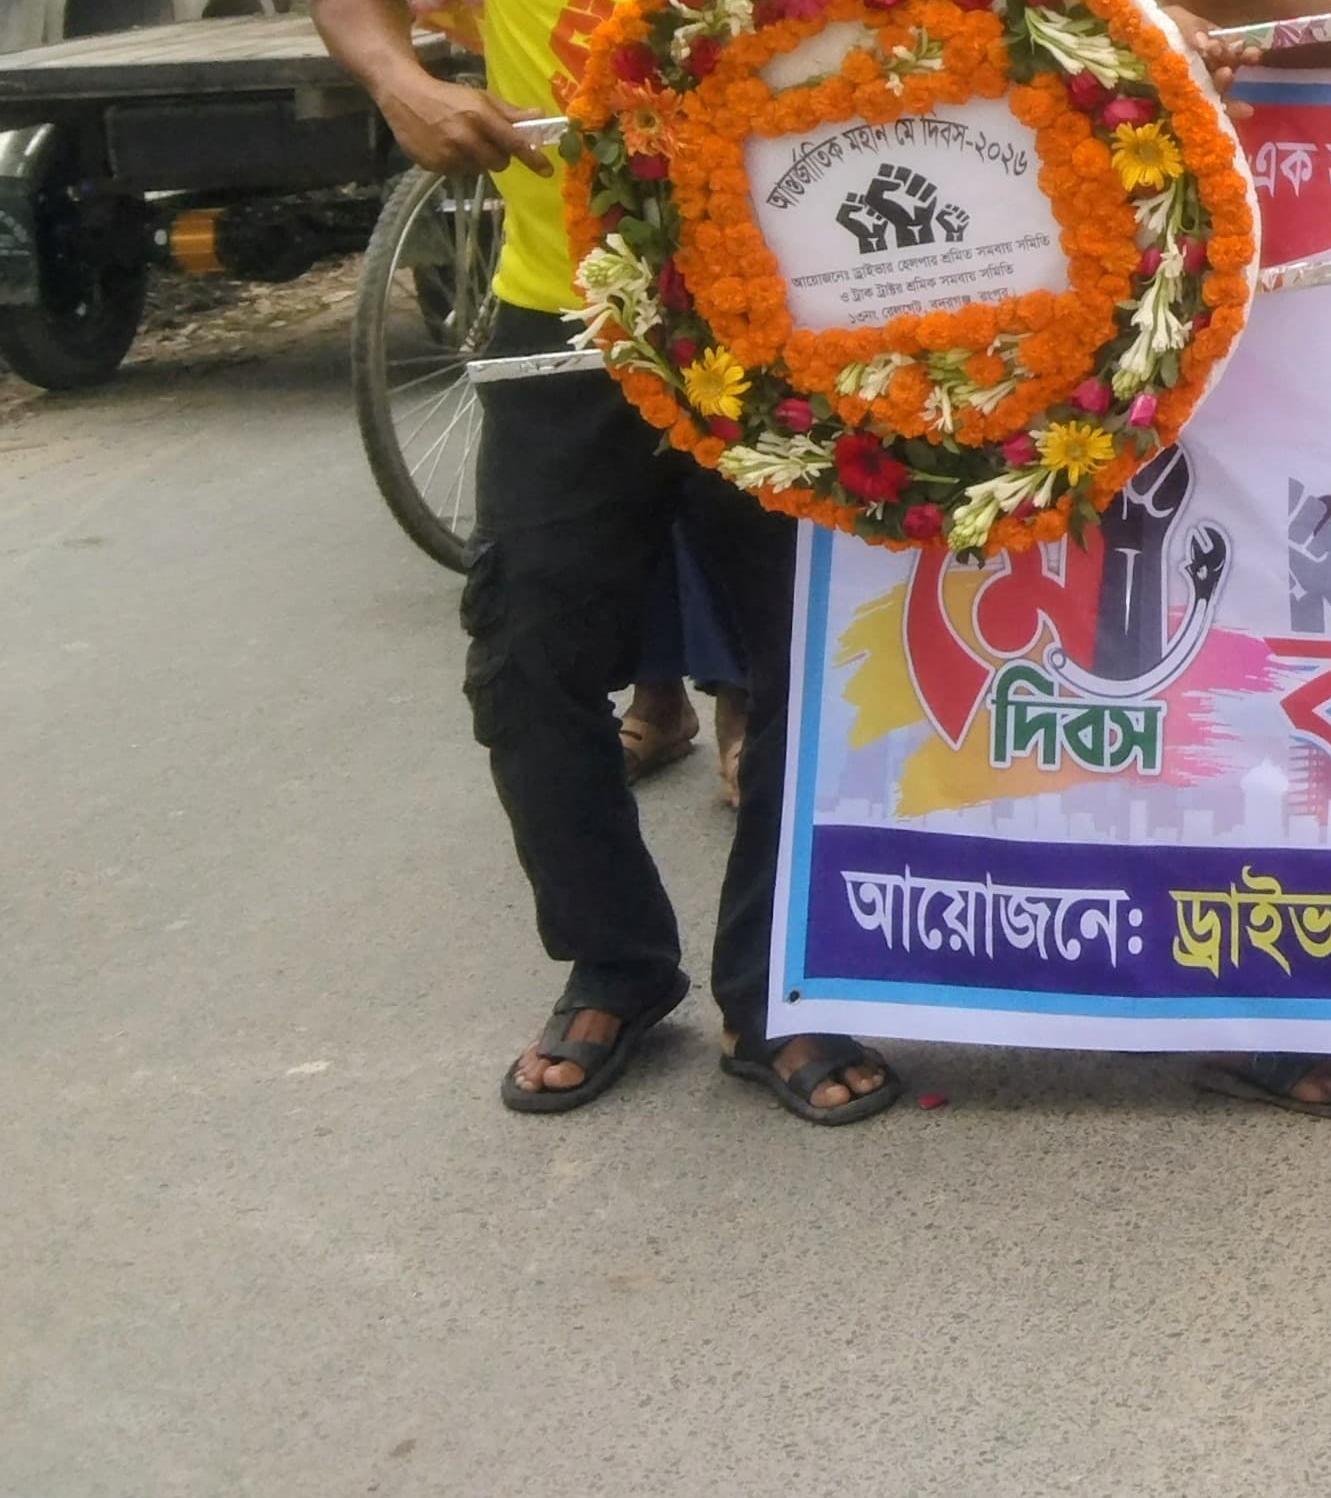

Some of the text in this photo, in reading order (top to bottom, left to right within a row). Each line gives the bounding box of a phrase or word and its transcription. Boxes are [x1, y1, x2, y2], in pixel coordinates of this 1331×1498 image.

[842, 124, 890, 153] মহান
[894, 117, 915, 146] মে
[920, 111, 1028, 176] দিবস-২০২৬
[1254, 141, 1318, 198] এক
[987, 659, 1166, 774] দিবস
[842, 864, 1144, 968] আয়োজনে:
